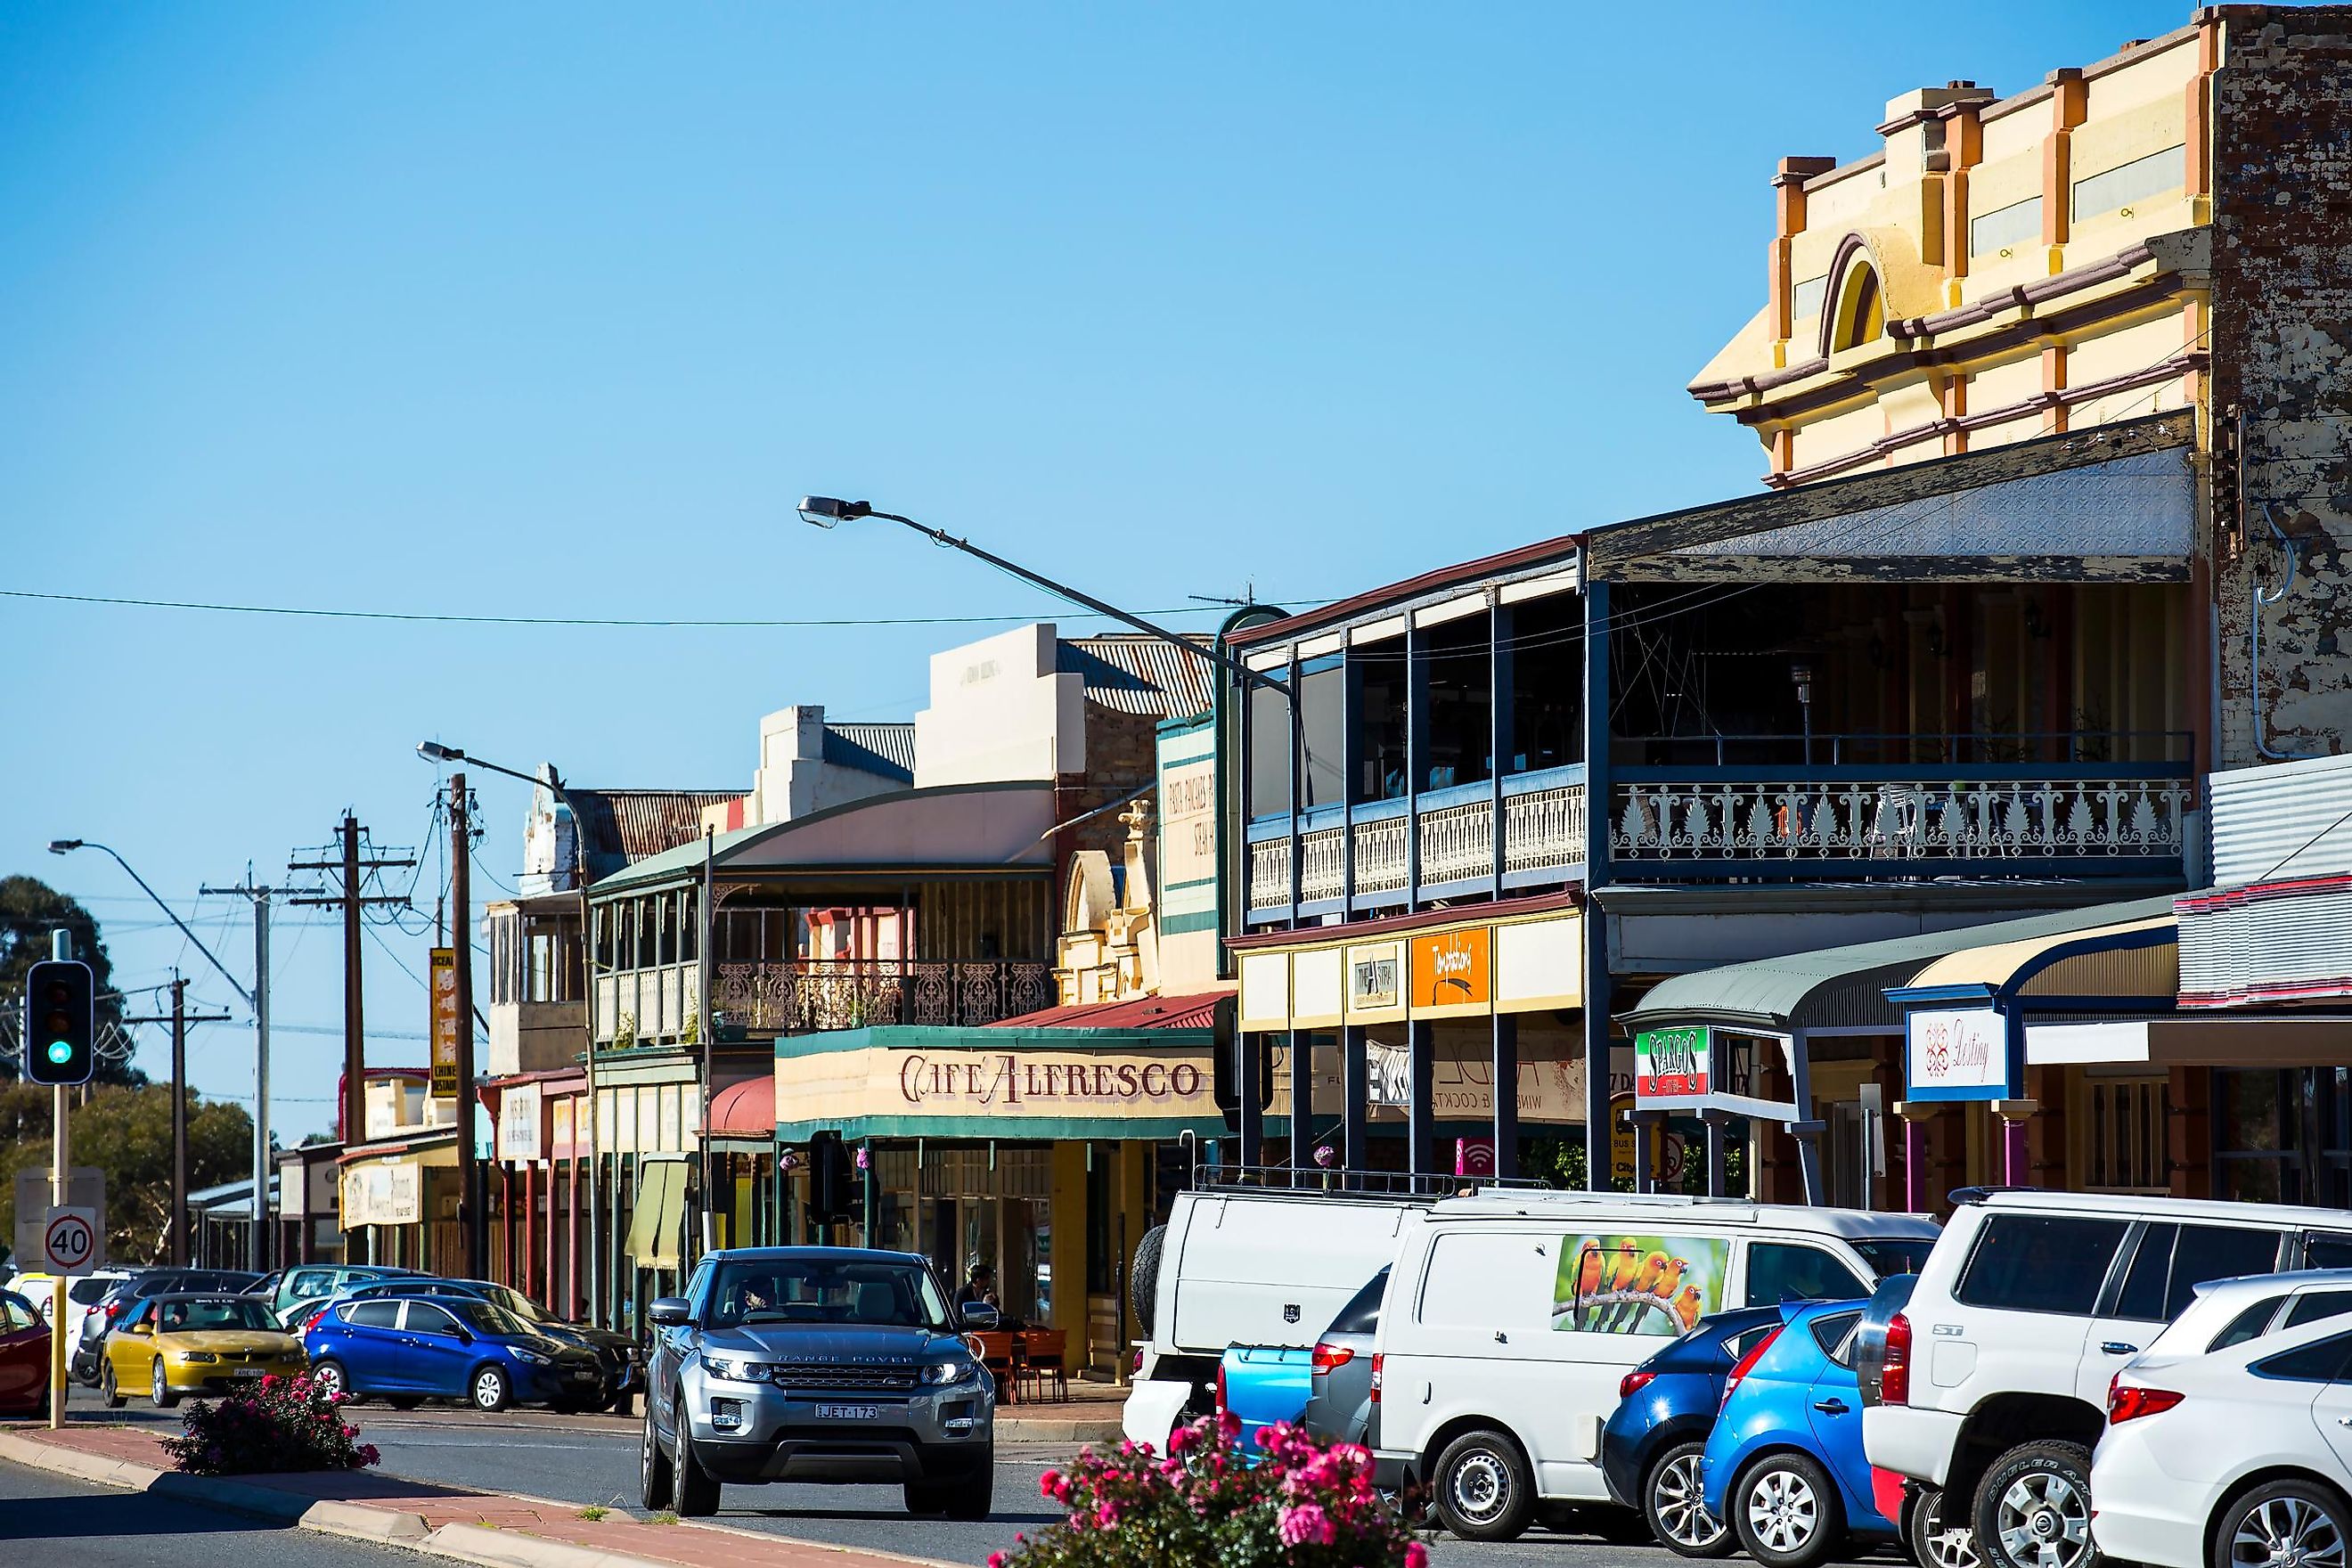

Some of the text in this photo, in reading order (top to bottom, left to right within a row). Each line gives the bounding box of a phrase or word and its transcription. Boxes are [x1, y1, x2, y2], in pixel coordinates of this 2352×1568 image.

[1953, 1018, 1989, 1082] Destiny
[978, 1055, 1200, 1104] ALFRESCO
[1613, 1139, 1629, 1148] BUS
[51, 1229, 87, 1254] 40
[1932, 1324, 1964, 1335] ST
[778, 1354, 913, 1364] RANGE ROVER
[1988, 1458, 2060, 1502] DUELER
